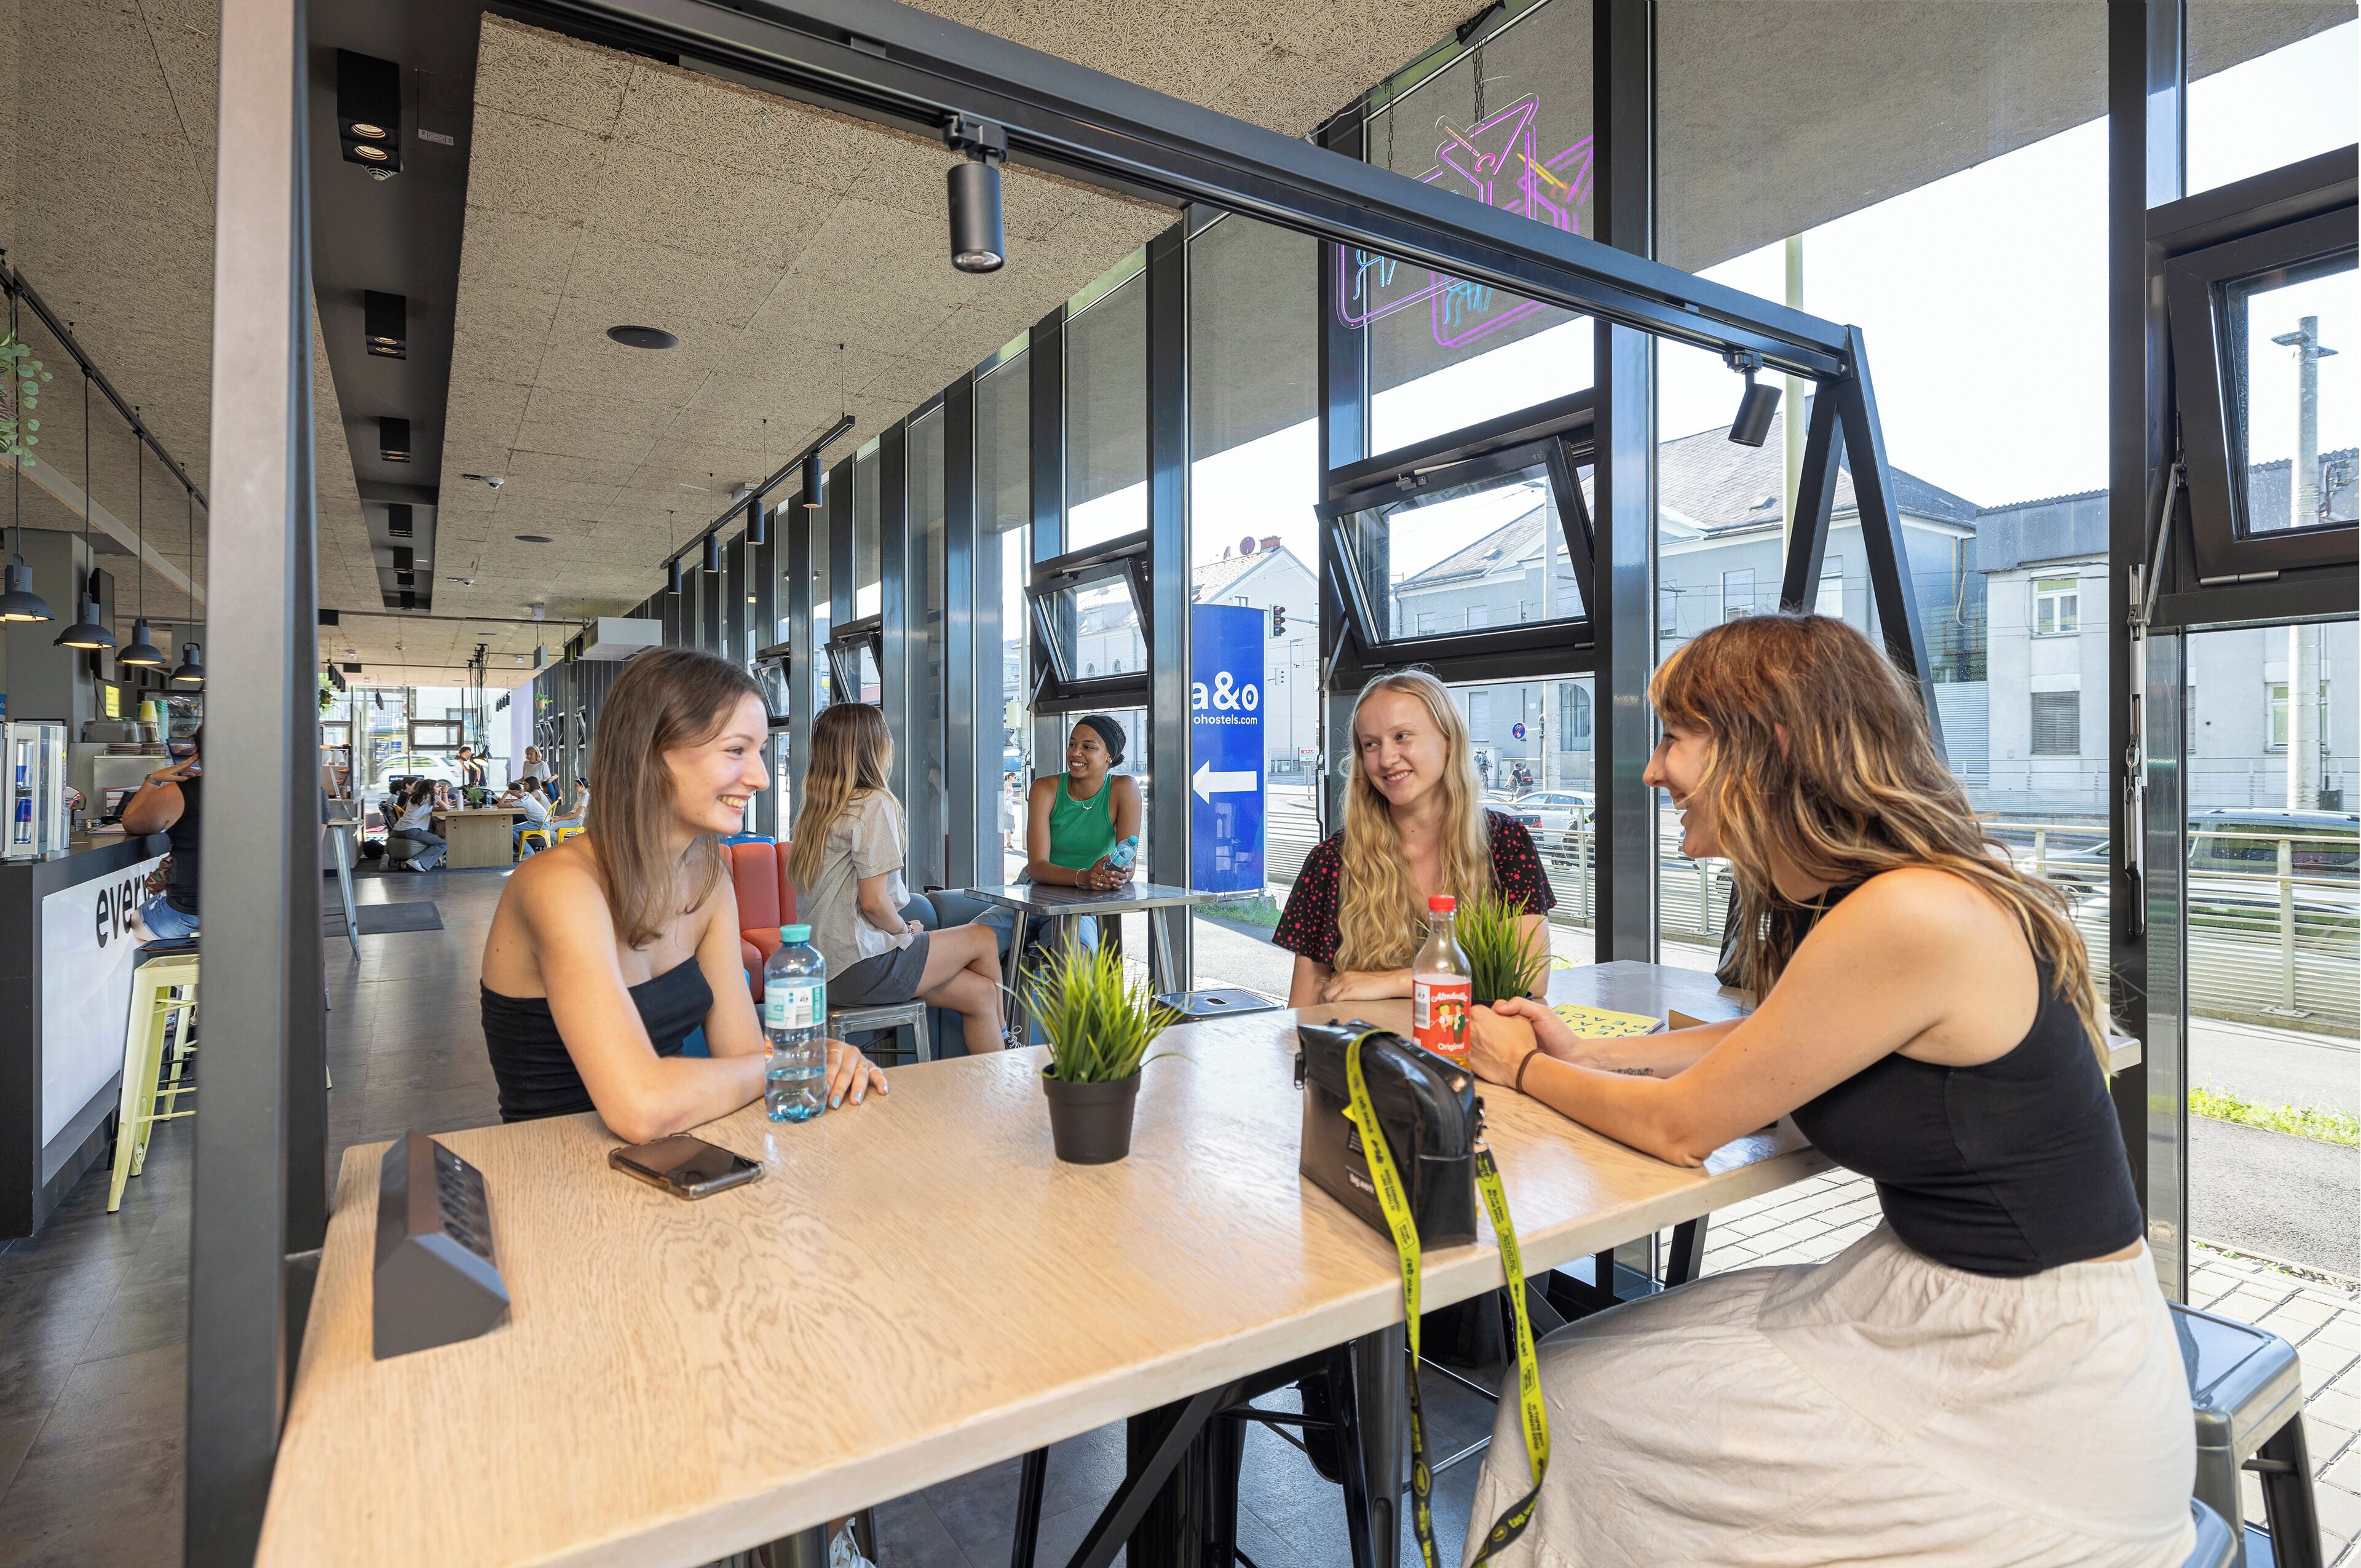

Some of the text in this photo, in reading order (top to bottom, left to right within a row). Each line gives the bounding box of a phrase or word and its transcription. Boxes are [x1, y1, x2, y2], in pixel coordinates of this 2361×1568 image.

[1192, 671, 1259, 711] a&o
[1193, 713, 1258, 724] ohostels.com
[1437, 1042, 1465, 1052] Original
